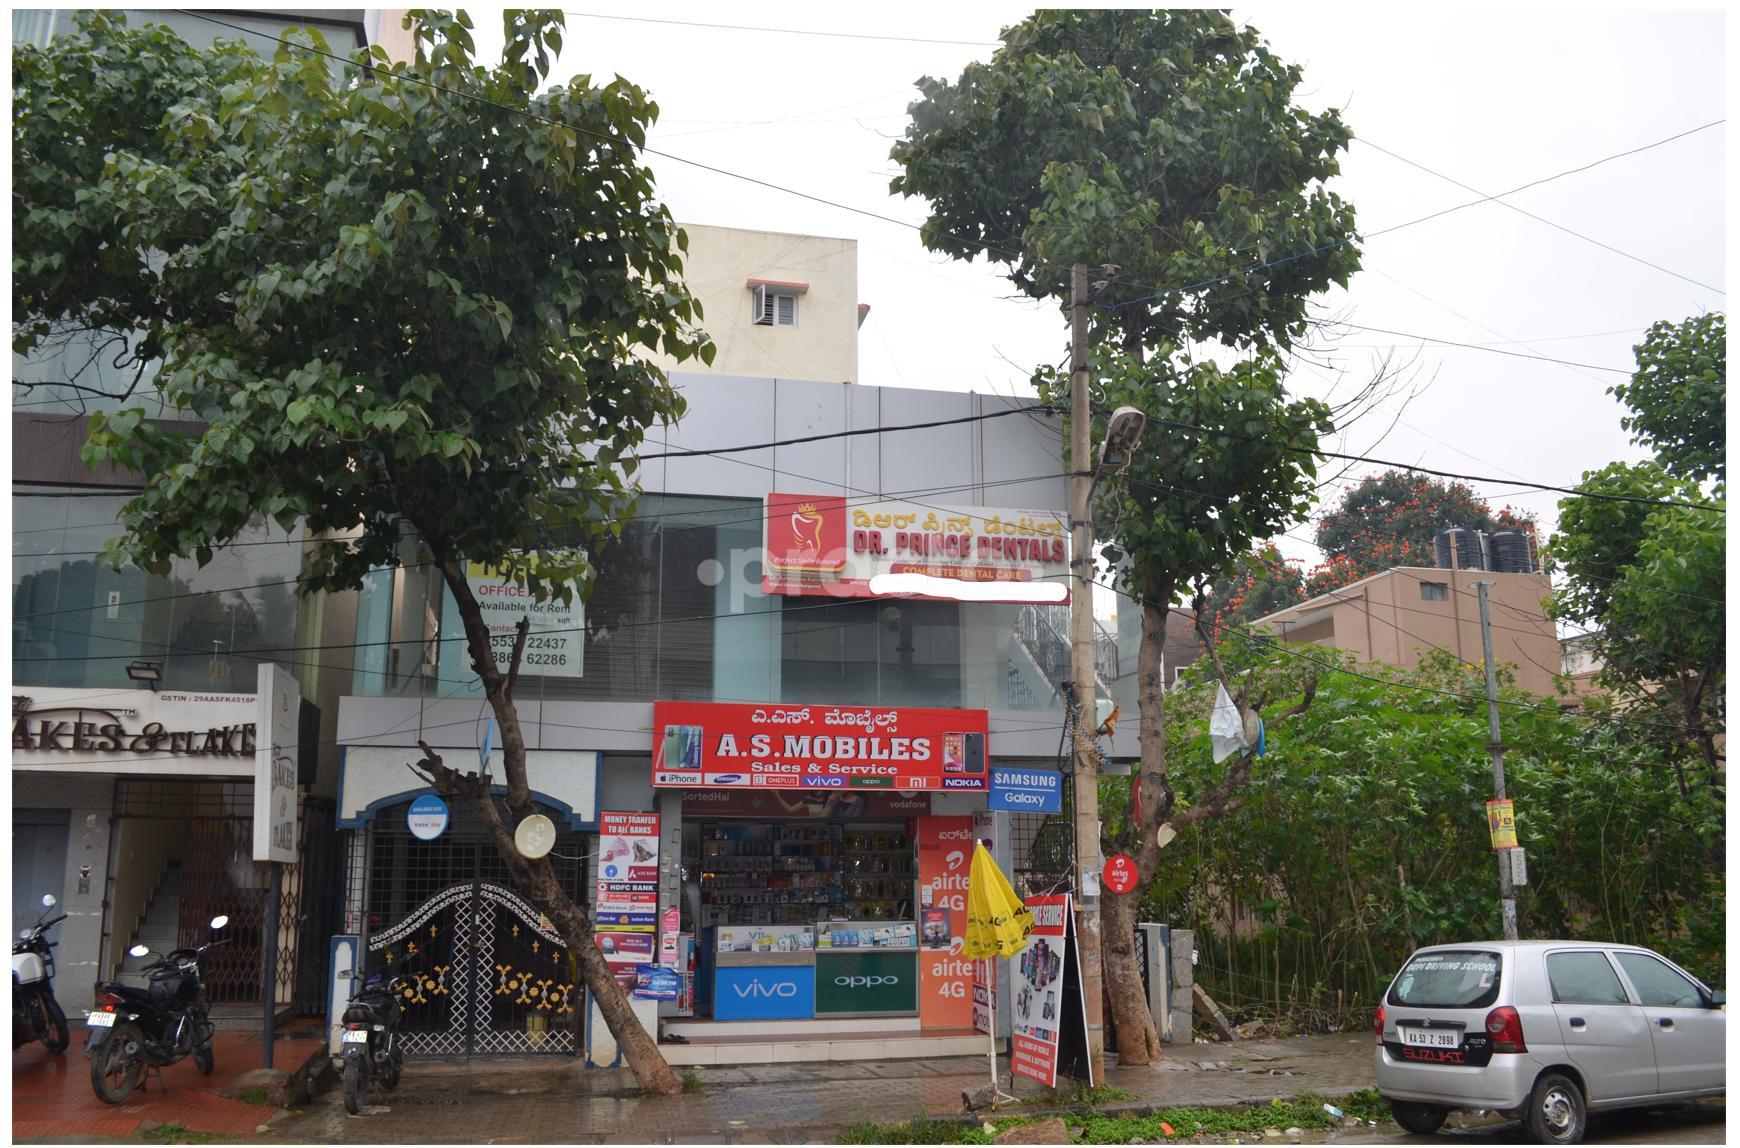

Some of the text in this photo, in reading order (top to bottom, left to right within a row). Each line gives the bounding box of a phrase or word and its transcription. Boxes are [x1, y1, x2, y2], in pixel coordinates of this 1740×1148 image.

[854, 530, 1066, 562] DR. PRINCE DENTALS
[902, 567, 1021, 580] COMPLETE DENTAL CARE
[479, 585, 526, 597] OFFICE
[479, 601, 571, 614] Available for Rent
[527, 637, 567, 649] 22437
[526, 653, 567, 666] 62286
[161, 694, 187, 702] GSTIN
[194, 695, 256, 703] 29AASFK4518P
[12, 719, 124, 753] AKES
[130, 721, 167, 754] &
[169, 722, 256, 758] FLAKE
[751, 762, 898, 775] Sales & Service
[272, 759, 295, 792] BAKES
[668, 772, 697, 783] iPhone
[768, 777, 796, 785] ONEPLUS
[862, 778, 881, 786] oppo
[994, 772, 1056, 788] SAMSUNG
[945, 779, 982, 788] NOKIA
[890, 800, 927, 809] vodafone
[1005, 792, 1045, 808] Galaxy
[604, 815, 627, 823] MONEY
[608, 825, 617, 834] TO
[630, 826, 652, 834] BANKS
[1111, 869, 1129, 877] airtel
[932, 872, 970, 890] airte
[938, 895, 965, 911] 4G
[1042, 904, 1063, 926] SERVICE
[932, 959, 973, 977] airte
[1425, 962, 1460, 971] DRIVING
[1461, 962, 1496, 972] SCHOOL
[834, 975, 899, 988] oppo
[1479, 973, 1492, 988] L
[733, 979, 797, 998] vivo
[938, 981, 965, 998] 4G
[1409, 1033, 1417, 1044] KA
[1418, 1034, 1426, 1044] 53
[1430, 1035, 1434, 1045] Z
[1402, 1047, 1465, 1063] SUZUKI
